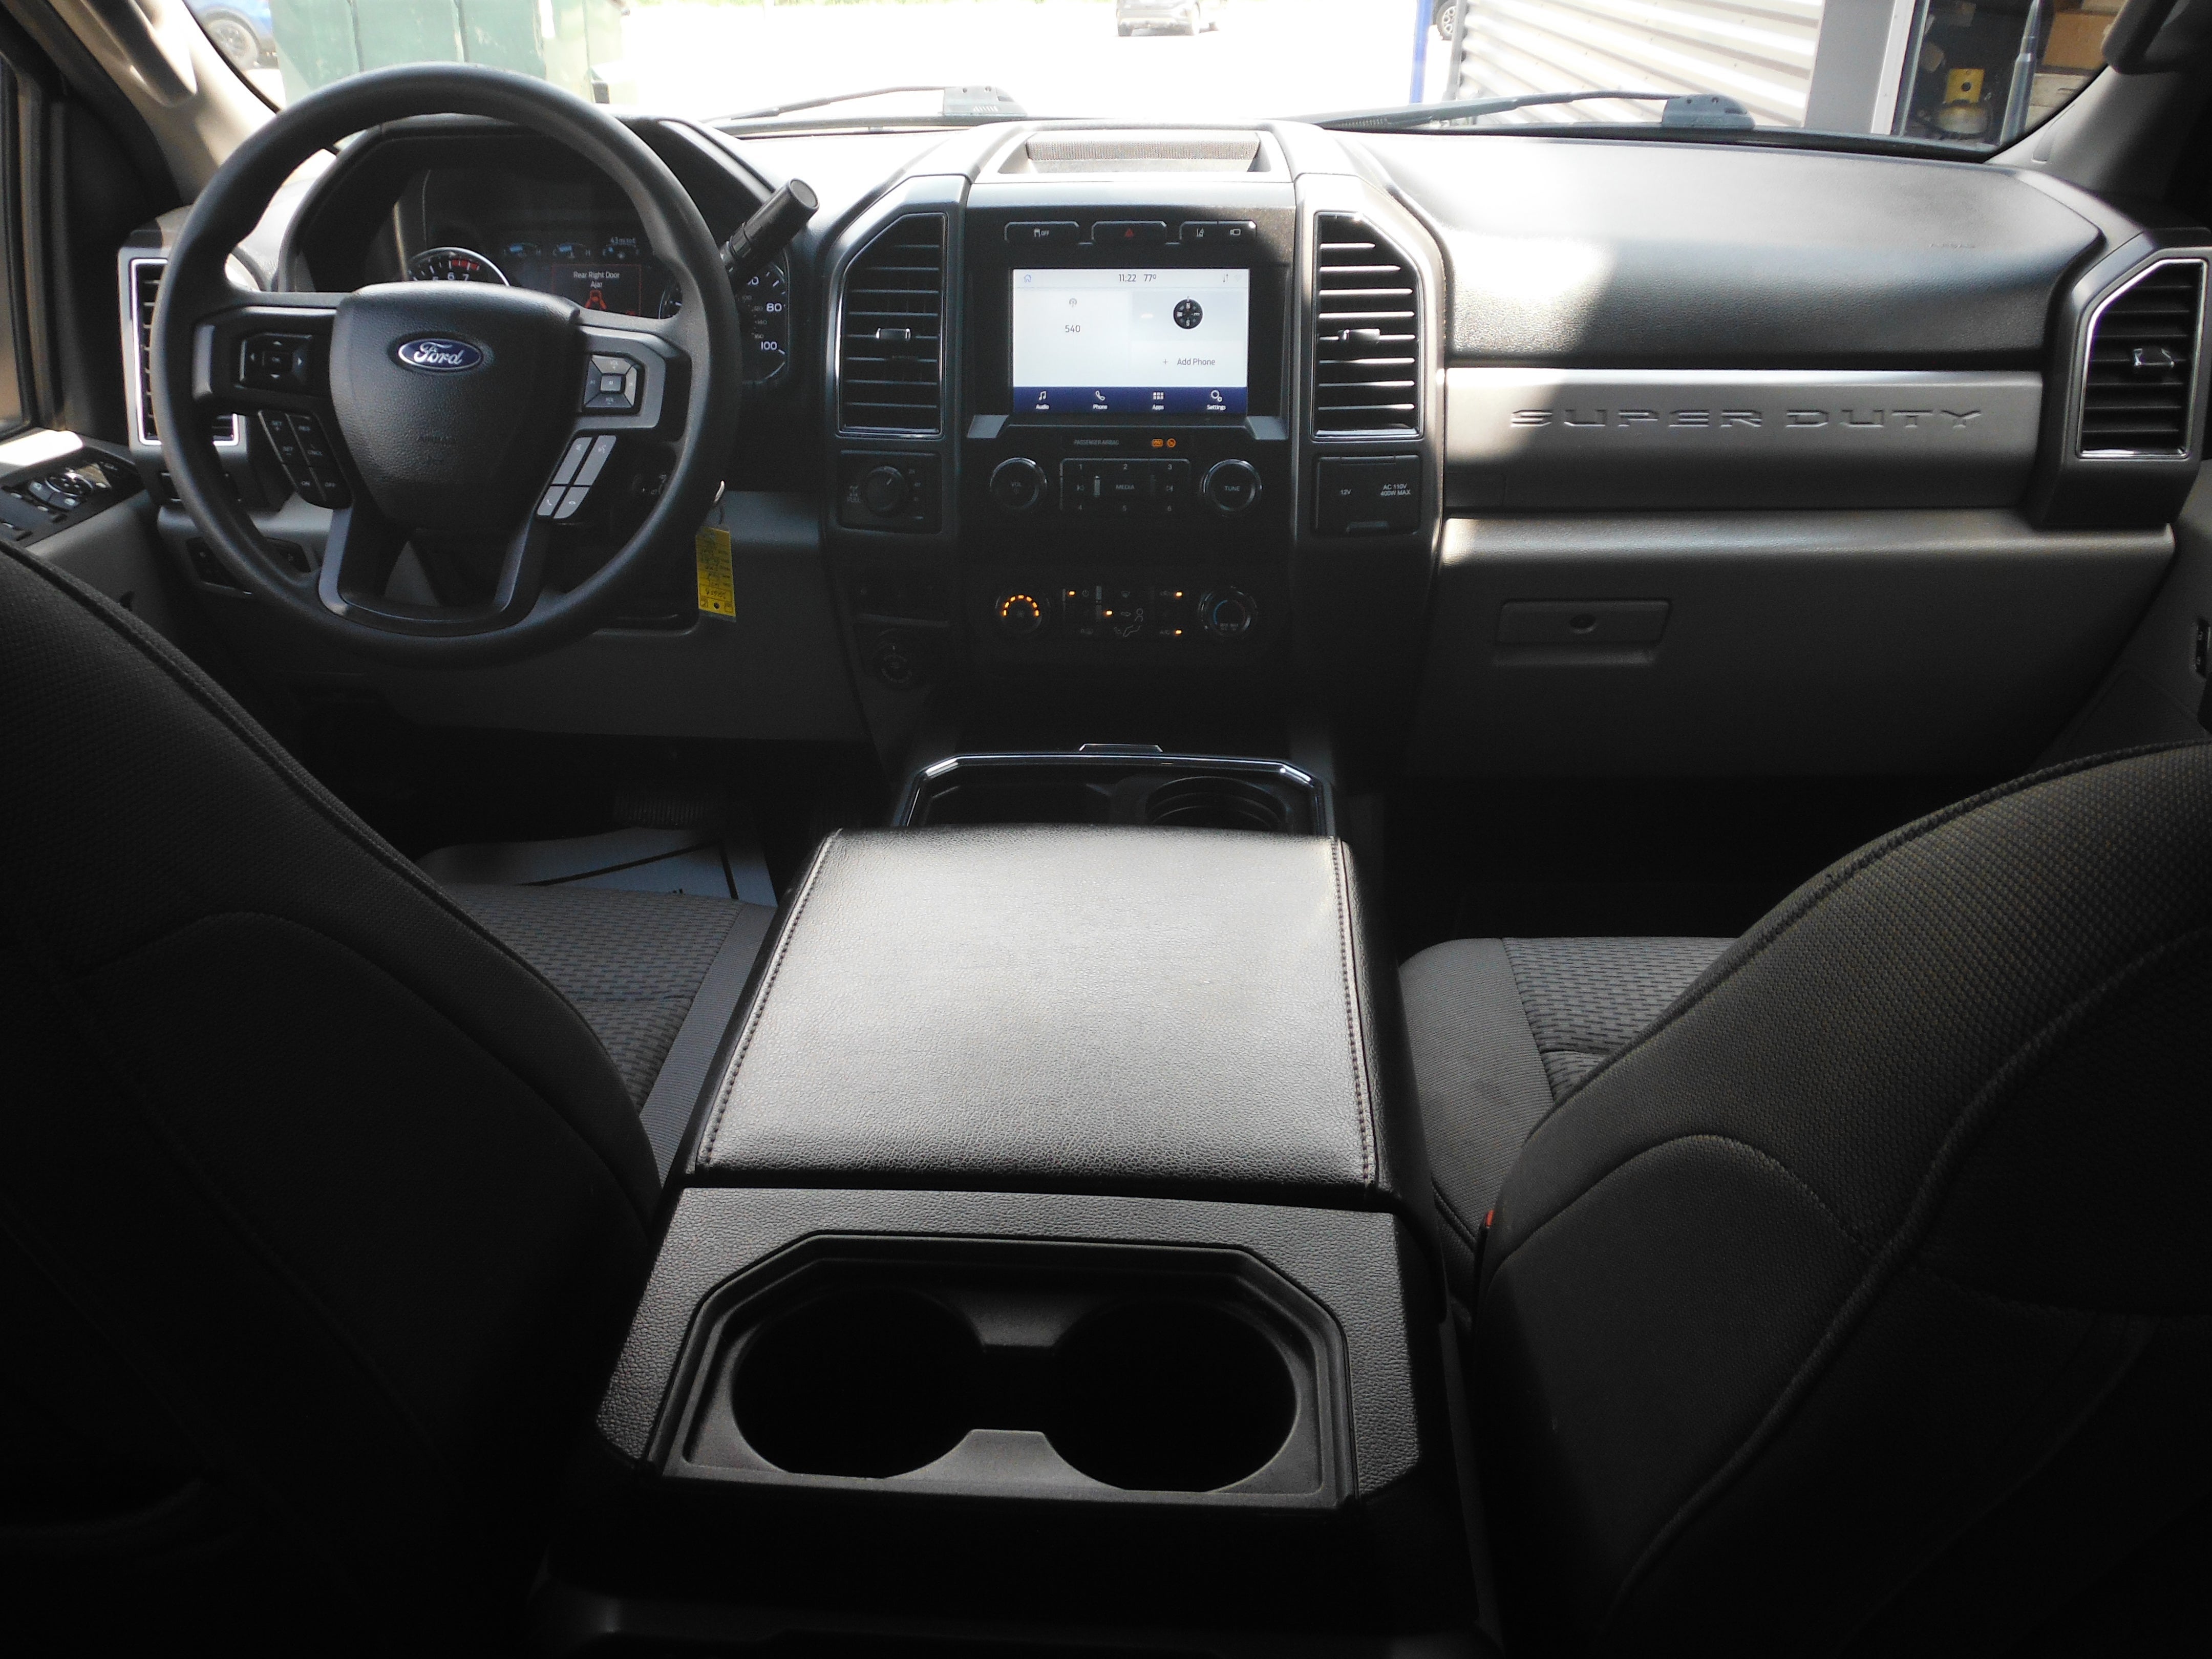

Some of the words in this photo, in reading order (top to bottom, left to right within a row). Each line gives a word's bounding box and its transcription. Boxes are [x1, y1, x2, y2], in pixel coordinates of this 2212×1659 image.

[447, 271, 455, 280] 6
[588, 271, 604, 280] Right
[590, 280, 603, 288] Ajar
[766, 302, 782, 312] 80
[1065, 325, 1080, 333] 540
[760, 341, 778, 350] 100
[414, 342, 465, 365] Ford
[1511, 410, 1762, 428] SUPER
[1785, 410, 1982, 428] DUTY
